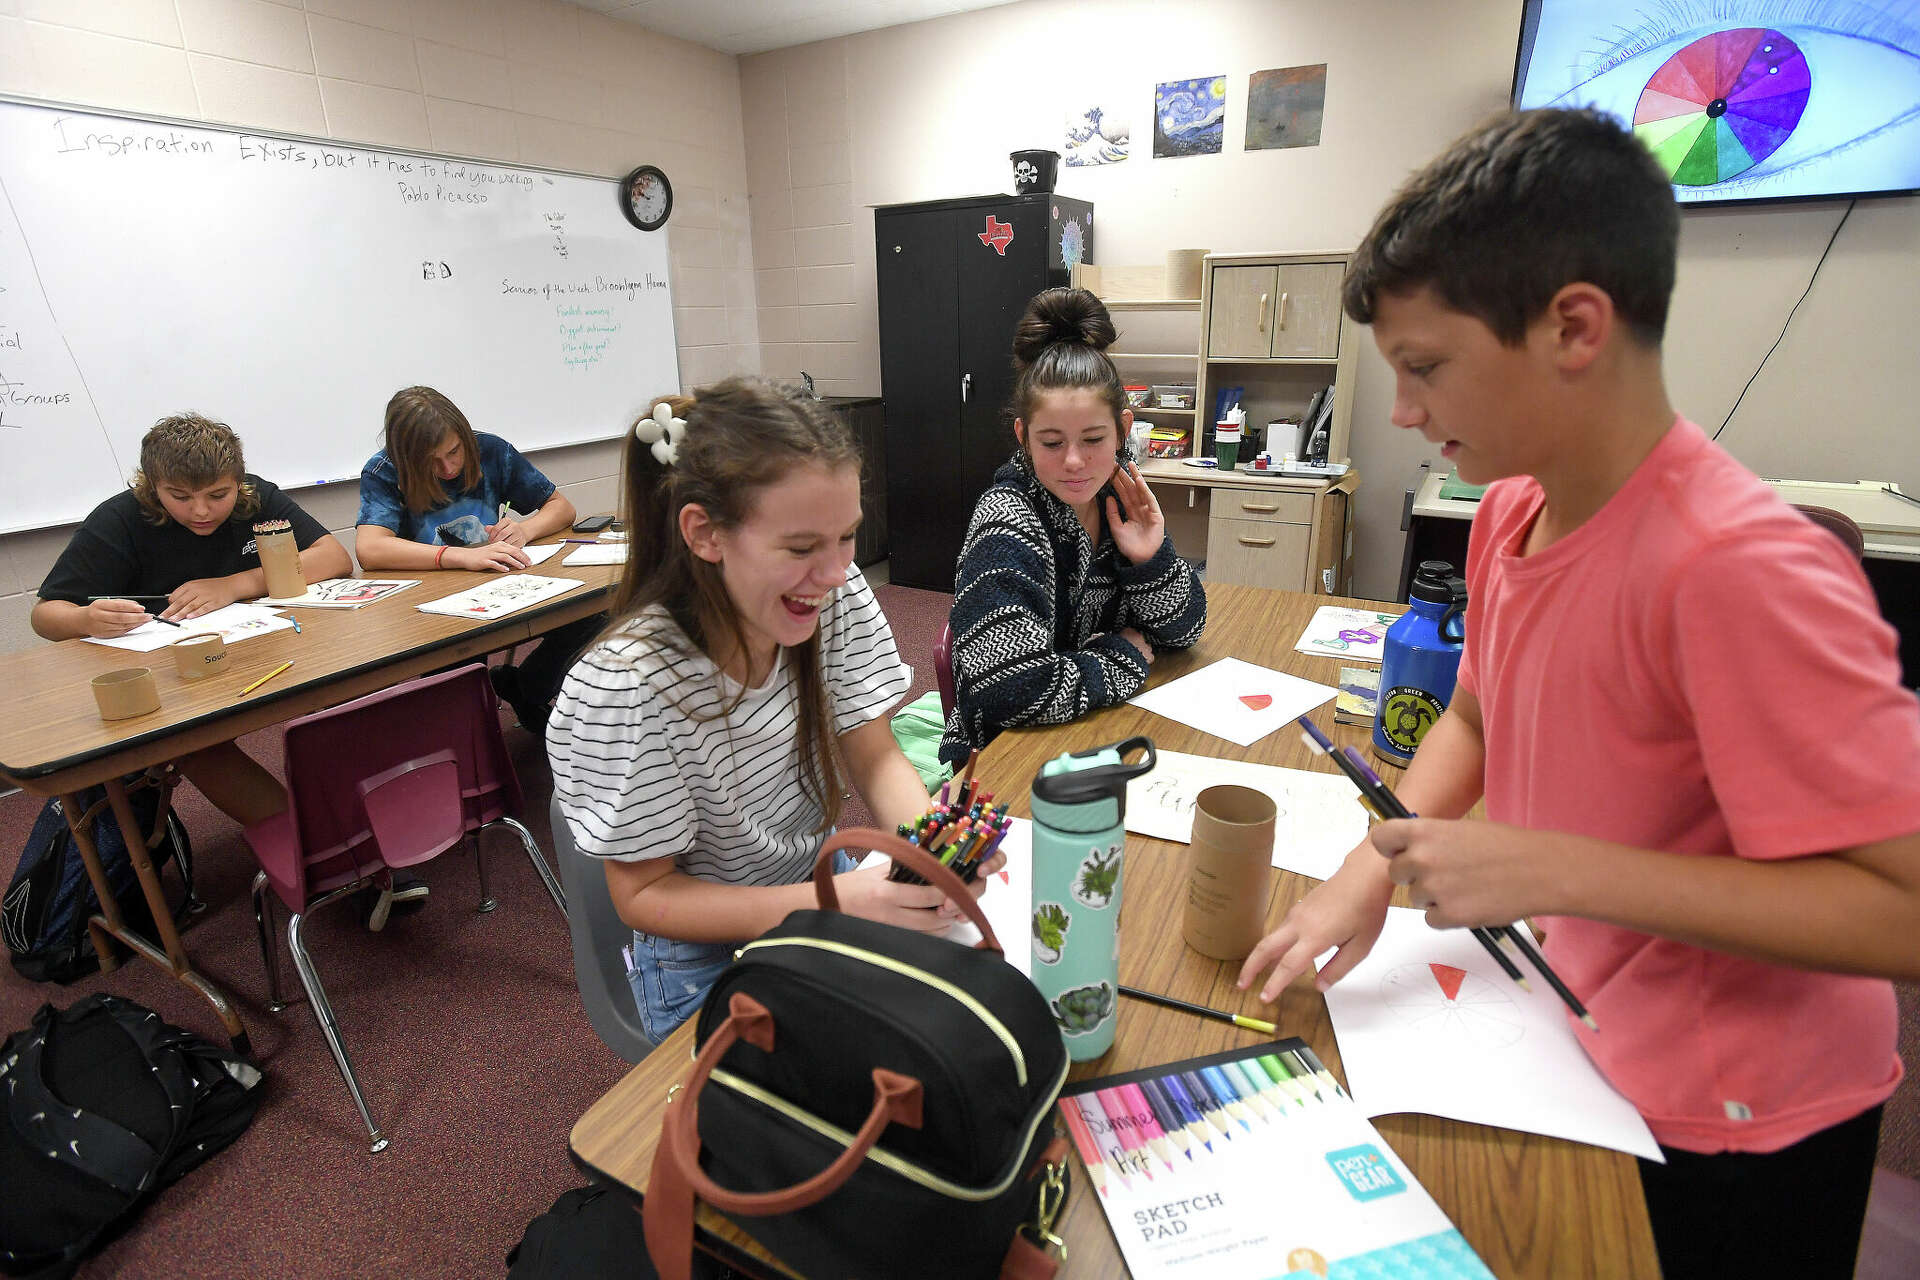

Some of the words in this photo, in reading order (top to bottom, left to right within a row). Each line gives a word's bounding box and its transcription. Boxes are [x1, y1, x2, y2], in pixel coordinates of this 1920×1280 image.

[54, 116, 214, 156] Inspiration
[321, 149, 357, 168] but
[367, 151, 380, 169] it
[388, 157, 413, 174] has
[420, 160, 436, 178] to
[443, 162, 466, 180] find
[469, 169, 497, 188] you
[398, 182, 430, 204] Pablo
[436, 184, 489, 204] Picasso
[10, 390, 71, 406] Groups
[1079, 1110, 1156, 1135] Summer
[1109, 1145, 1150, 1175] Art
[1348, 1166, 1396, 1193] GEAR
[1133, 1192, 1224, 1225] SKETCH
[1141, 1219, 1188, 1243] PAD
